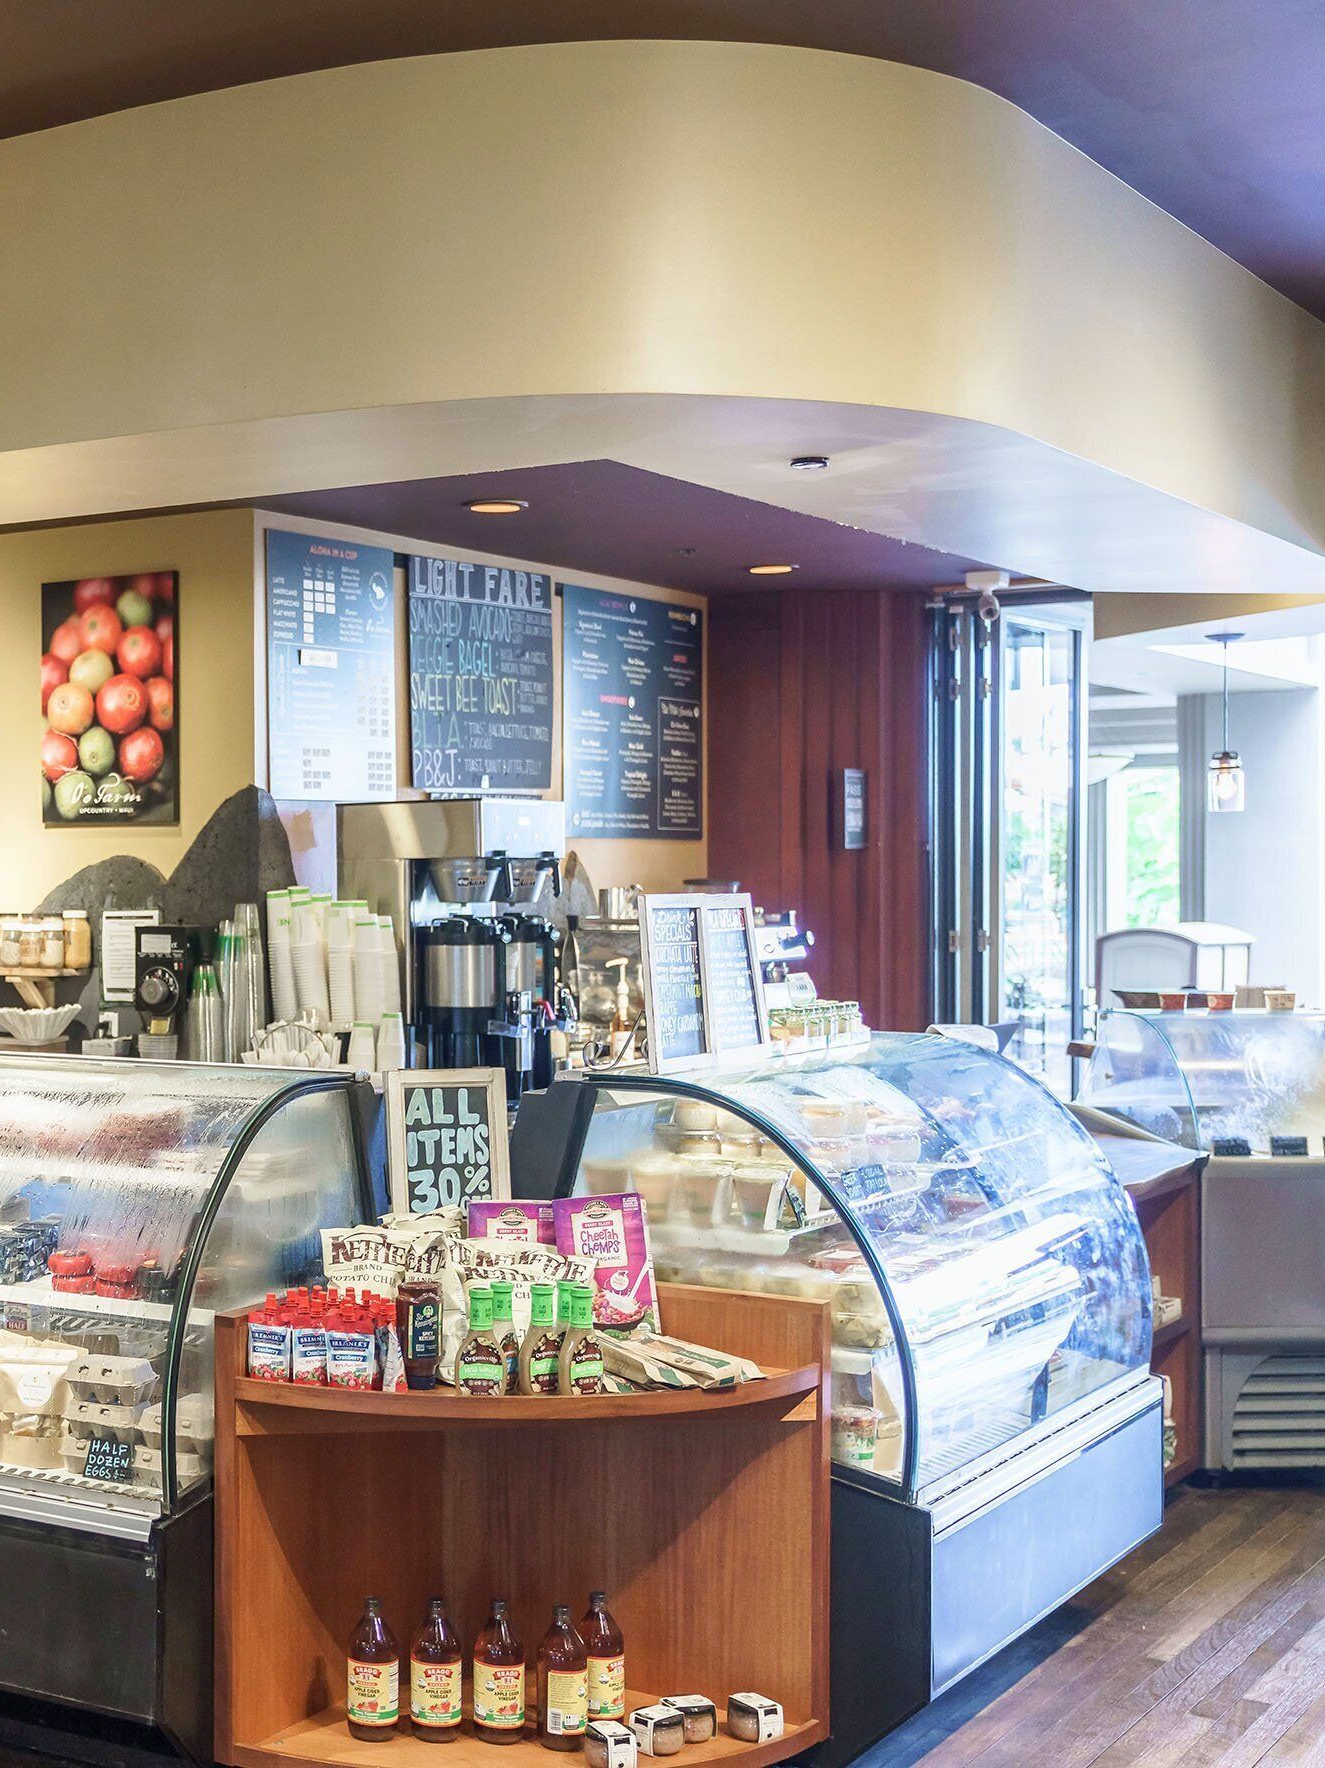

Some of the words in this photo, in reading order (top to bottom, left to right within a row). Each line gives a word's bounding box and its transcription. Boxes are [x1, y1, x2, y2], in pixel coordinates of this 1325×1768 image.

[414, 557, 474, 599] LIGHT
[484, 567, 544, 608] FARE
[410, 599, 462, 637] SMASHED
[410, 634, 454, 674] VEGGIE
[411, 673, 452, 711] SWEET
[455, 675, 478, 712] BEE
[655, 924, 692, 942] SPECIALS
[406, 1088, 480, 1125] ALL
[407, 1123, 490, 1168] ITEMS
[408, 1166, 490, 1213] 30%
[353, 1264, 383, 1272] BRAND
[329, 1274, 370, 1282] POTATO
[254, 1347, 279, 1356] Cranberry
[335, 1354, 363, 1362] Cranberry
[91, 1440, 128, 1456] HALF
[89, 1454, 130, 1469] DOZEN
[85, 1465, 111, 1479] EGGS
[356, 1666, 377, 1675] BRAGG
